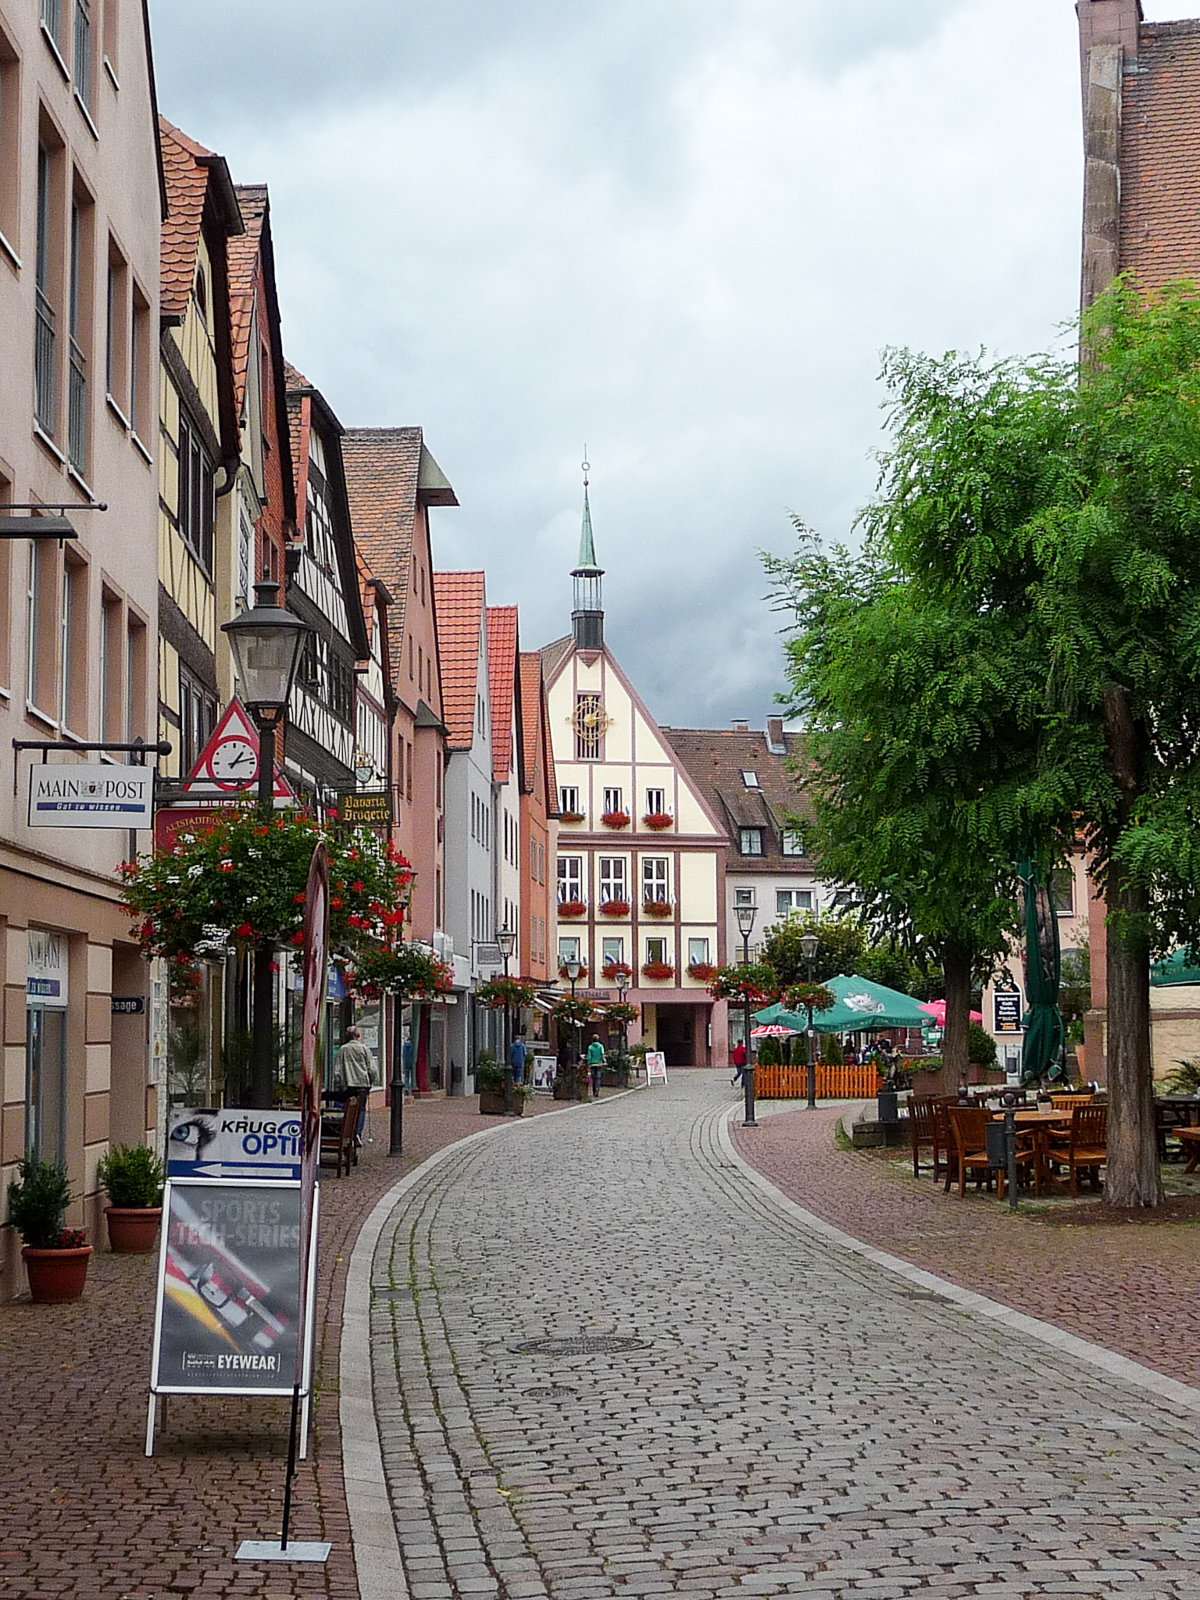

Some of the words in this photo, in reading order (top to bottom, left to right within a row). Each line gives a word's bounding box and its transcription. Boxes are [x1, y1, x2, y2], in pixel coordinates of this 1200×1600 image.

[37, 779, 79, 798] MAIN
[105, 780, 146, 799] POST
[56, 802, 71, 811] Gut
[75, 803, 85, 811] zu
[343, 808, 390, 822] Drogerie
[111, 1001, 137, 1013] ssage
[221, 1120, 277, 1134] KRUG
[242, 1134, 302, 1156] OPTI
[200, 1199, 281, 1224] SPORTS
[217, 1354, 276, 1370] EYEWEAR
